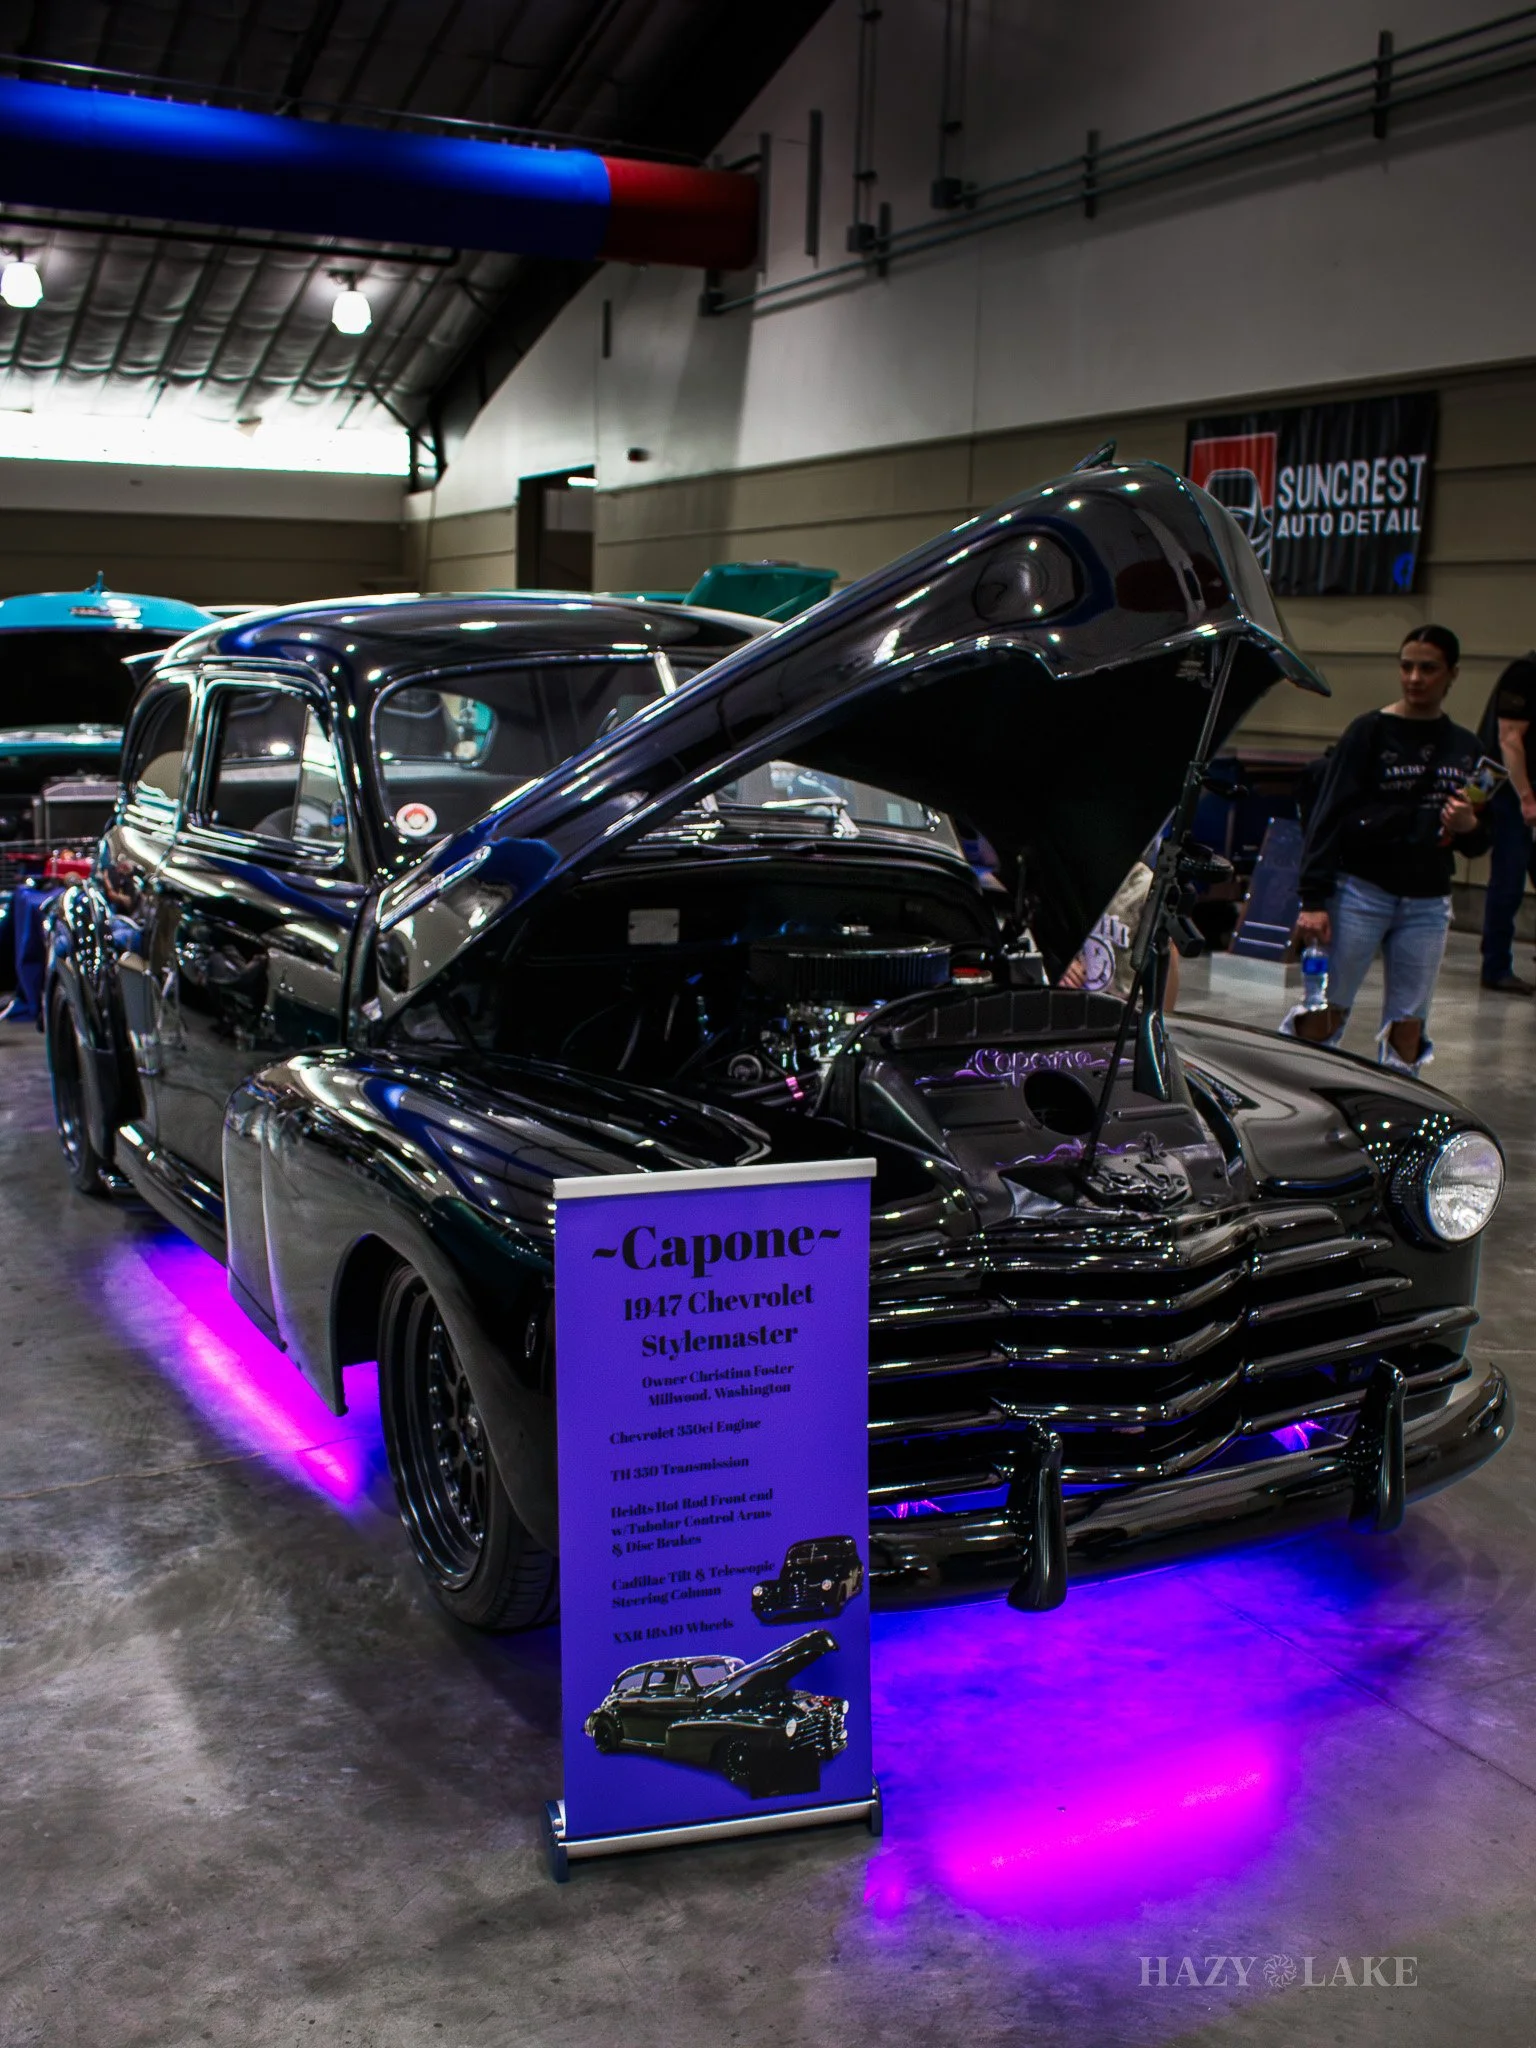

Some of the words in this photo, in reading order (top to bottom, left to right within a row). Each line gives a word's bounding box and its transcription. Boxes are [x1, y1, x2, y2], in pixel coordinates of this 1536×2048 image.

[1278, 454, 1427, 510] SUNCREST
[1276, 511, 1333, 538] AUTO
[1339, 507, 1421, 535] DETAIL
[623, 1294, 683, 1321] 1947
[688, 1283, 814, 1314] Chevrolet
[641, 1325, 799, 1360] Stylemaster
[641, 1373, 687, 1389] Owner
[688, 1367, 751, 1384] Christina
[753, 1363, 794, 1378] Foster
[714, 1383, 792, 1402] Washington
[609, 1426, 675, 1445] Chevrolet
[716, 1419, 762, 1435] Engine
[610, 1469, 631, 1482] TH
[633, 1466, 659, 1480] 350
[662, 1456, 749, 1476] Transmission
[656, 1499, 679, 1514] Hot
[682, 1494, 708, 1510] Rod
[710, 1491, 747, 1507] Front
[750, 1488, 774, 1502] end
[684, 1512, 735, 1529] Control
[737, 1508, 772, 1522] Arms
[612, 1541, 624, 1558] &
[626, 1538, 654, 1554] Disc
[656, 1533, 702, 1550] Brakes
[612, 1573, 665, 1590] Cadillac
[667, 1569, 693, 1584] Tilt
[695, 1567, 706, 1583] &
[709, 1561, 775, 1578] Telescopic
[611, 1593, 669, 1610] Steering
[670, 1584, 721, 1600] Column
[686, 1618, 734, 1634] Wheels
